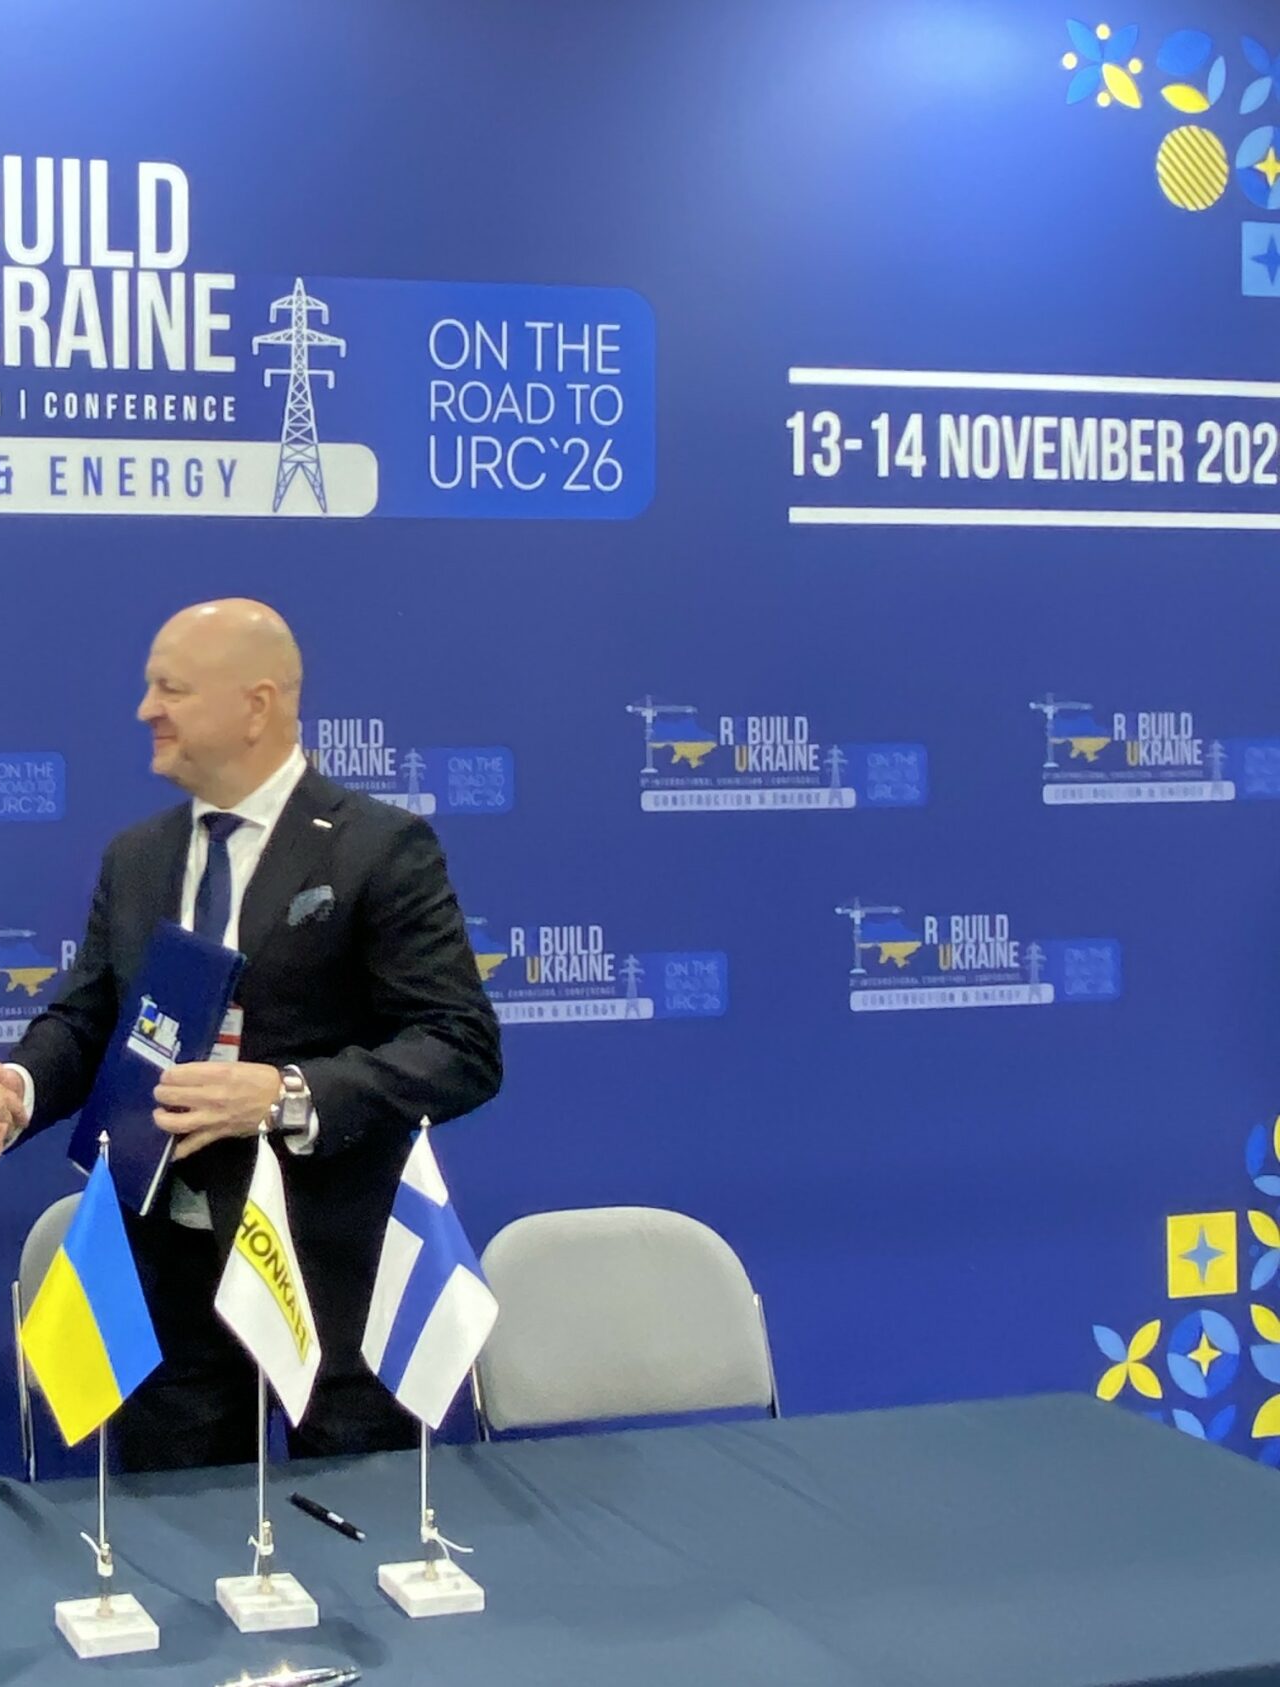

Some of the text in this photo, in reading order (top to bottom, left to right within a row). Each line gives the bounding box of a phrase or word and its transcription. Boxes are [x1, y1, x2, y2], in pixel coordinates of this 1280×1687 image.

[429, 318, 621, 375] ON THE
[43, 393, 238, 423] CONFERENCE
[430, 380, 624, 426] ROAD TO
[786, 411, 927, 478] 13-14
[939, 413, 1186, 483] NOVEMBER
[49, 455, 239, 499] ENERGY
[318, 718, 383, 748] BUILD
[721, 716, 808, 745] RBUILD
[1114, 712, 1192, 741] RBUILD
[735, 744, 819, 772] UKRAINE
[1127, 739, 1203, 767] UKRAINE
[25, 761, 54, 778] THE
[511, 926, 602, 956] RBUILD
[925, 915, 1007, 944] RBUILD
[526, 955, 615, 983] UKRAINE
[939, 942, 1019, 970] UKRAINE
